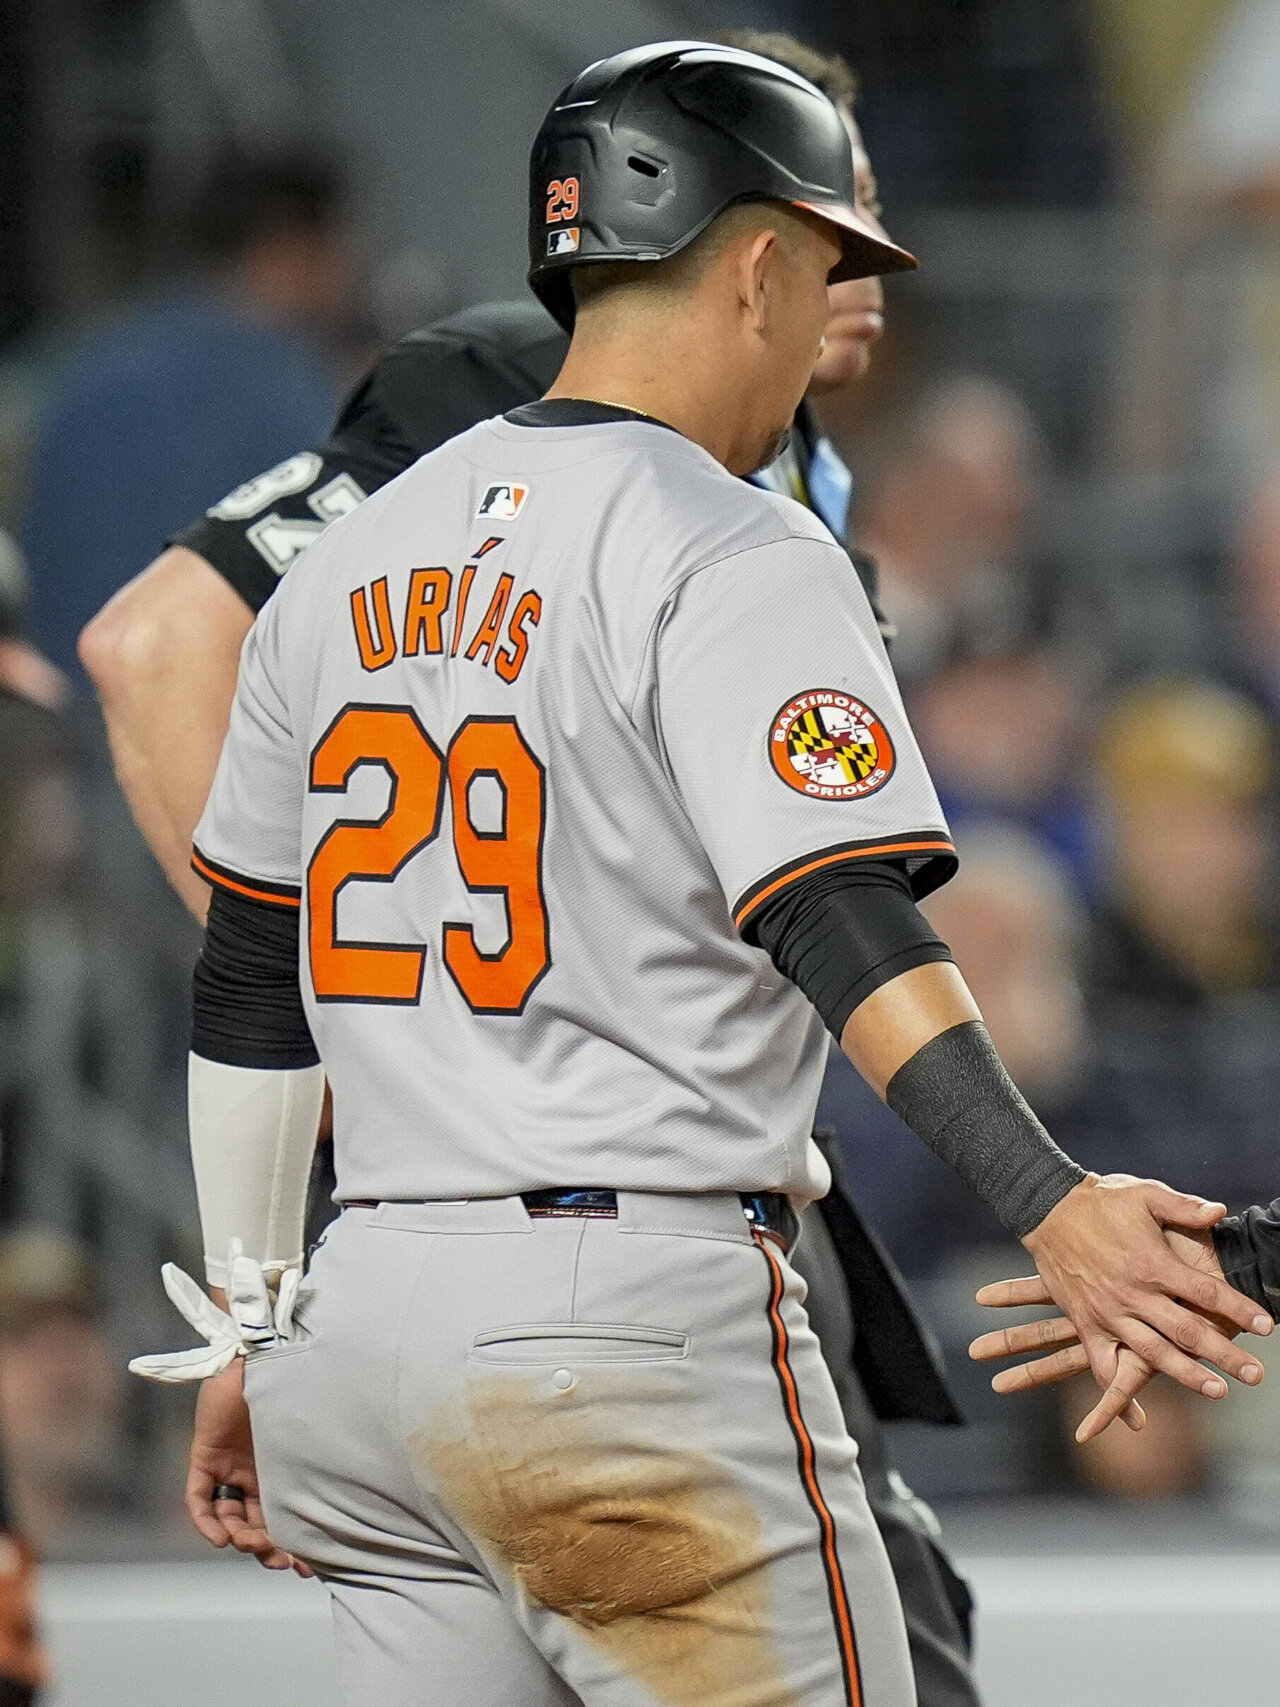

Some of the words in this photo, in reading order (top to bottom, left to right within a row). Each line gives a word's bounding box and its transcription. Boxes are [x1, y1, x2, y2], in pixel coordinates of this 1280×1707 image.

[546, 177, 579, 224] 29
[350, 536, 542, 686] URÍAS
[774, 693, 875, 743] BALTIMORE
[804, 767, 887, 797] ORIOLES
[308, 702, 553, 1017] 29
